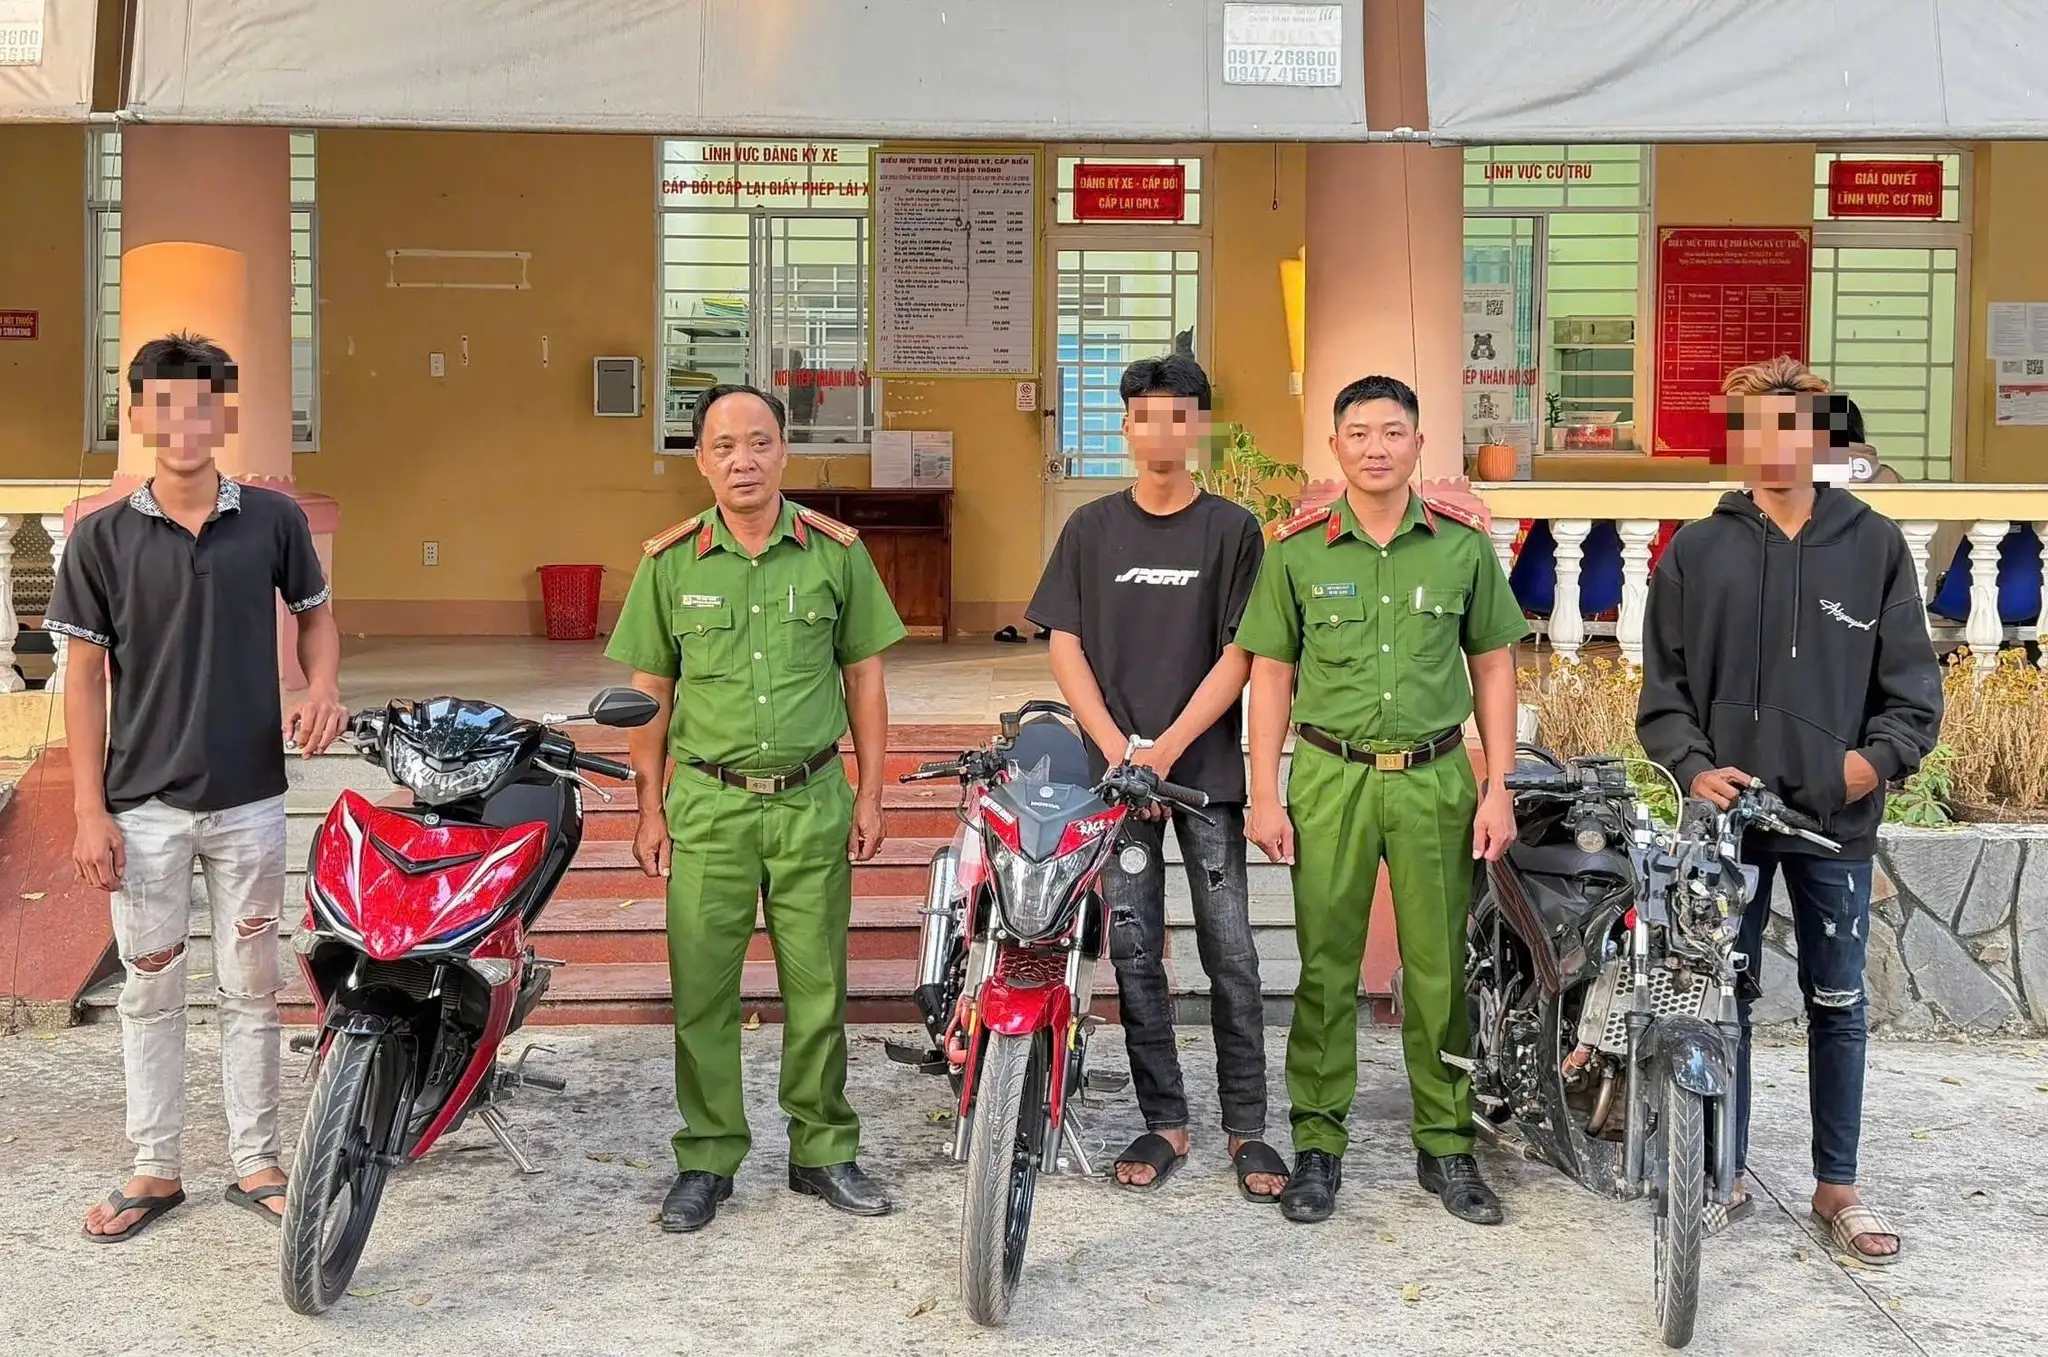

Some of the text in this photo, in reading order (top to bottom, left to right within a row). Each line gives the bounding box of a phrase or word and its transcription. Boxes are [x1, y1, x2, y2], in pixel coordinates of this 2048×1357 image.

[1227, 49, 1337, 66] 0917.268600
[1228, 66, 1337, 83] 0947.415615
[702, 144, 731, 161] LĨNH
[763, 144, 798, 162] ĐĂNG
[802, 145, 818, 162] KÝ
[822, 148, 838, 162] XE
[1484, 161, 1592, 182] LĨNH VỰC CƯ TRÚ
[1855, 169, 1918, 186] GIẢI QUYẾT
[662, 176, 688, 194] CẤP
[691, 174, 713, 194] ĐỔI
[717, 176, 742, 195] CẤP
[746, 181, 766, 200] LẠI
[769, 177, 798, 195] GIẤY
[802, 178, 835, 195] PHÉP
[839, 179, 858, 196] LÁI
[1080, 174, 1105, 189] ĐĂNG
[1107, 174, 1120, 189] KÝ
[1121, 177, 1133, 189] XE
[1142, 174, 1160, 189] CẤP
[1099, 194, 1117, 209] CẤP
[1136, 198, 1159, 209] GPLX
[1837, 191, 1933, 208] LĨNH VỰC CƯ TRÚ
[1463, 364, 1477, 385] IẾP
[1509, 366, 1520, 385] HỒ
[1523, 367, 1536, 385] SƠ
[1115, 567, 1200, 586] SPORT
